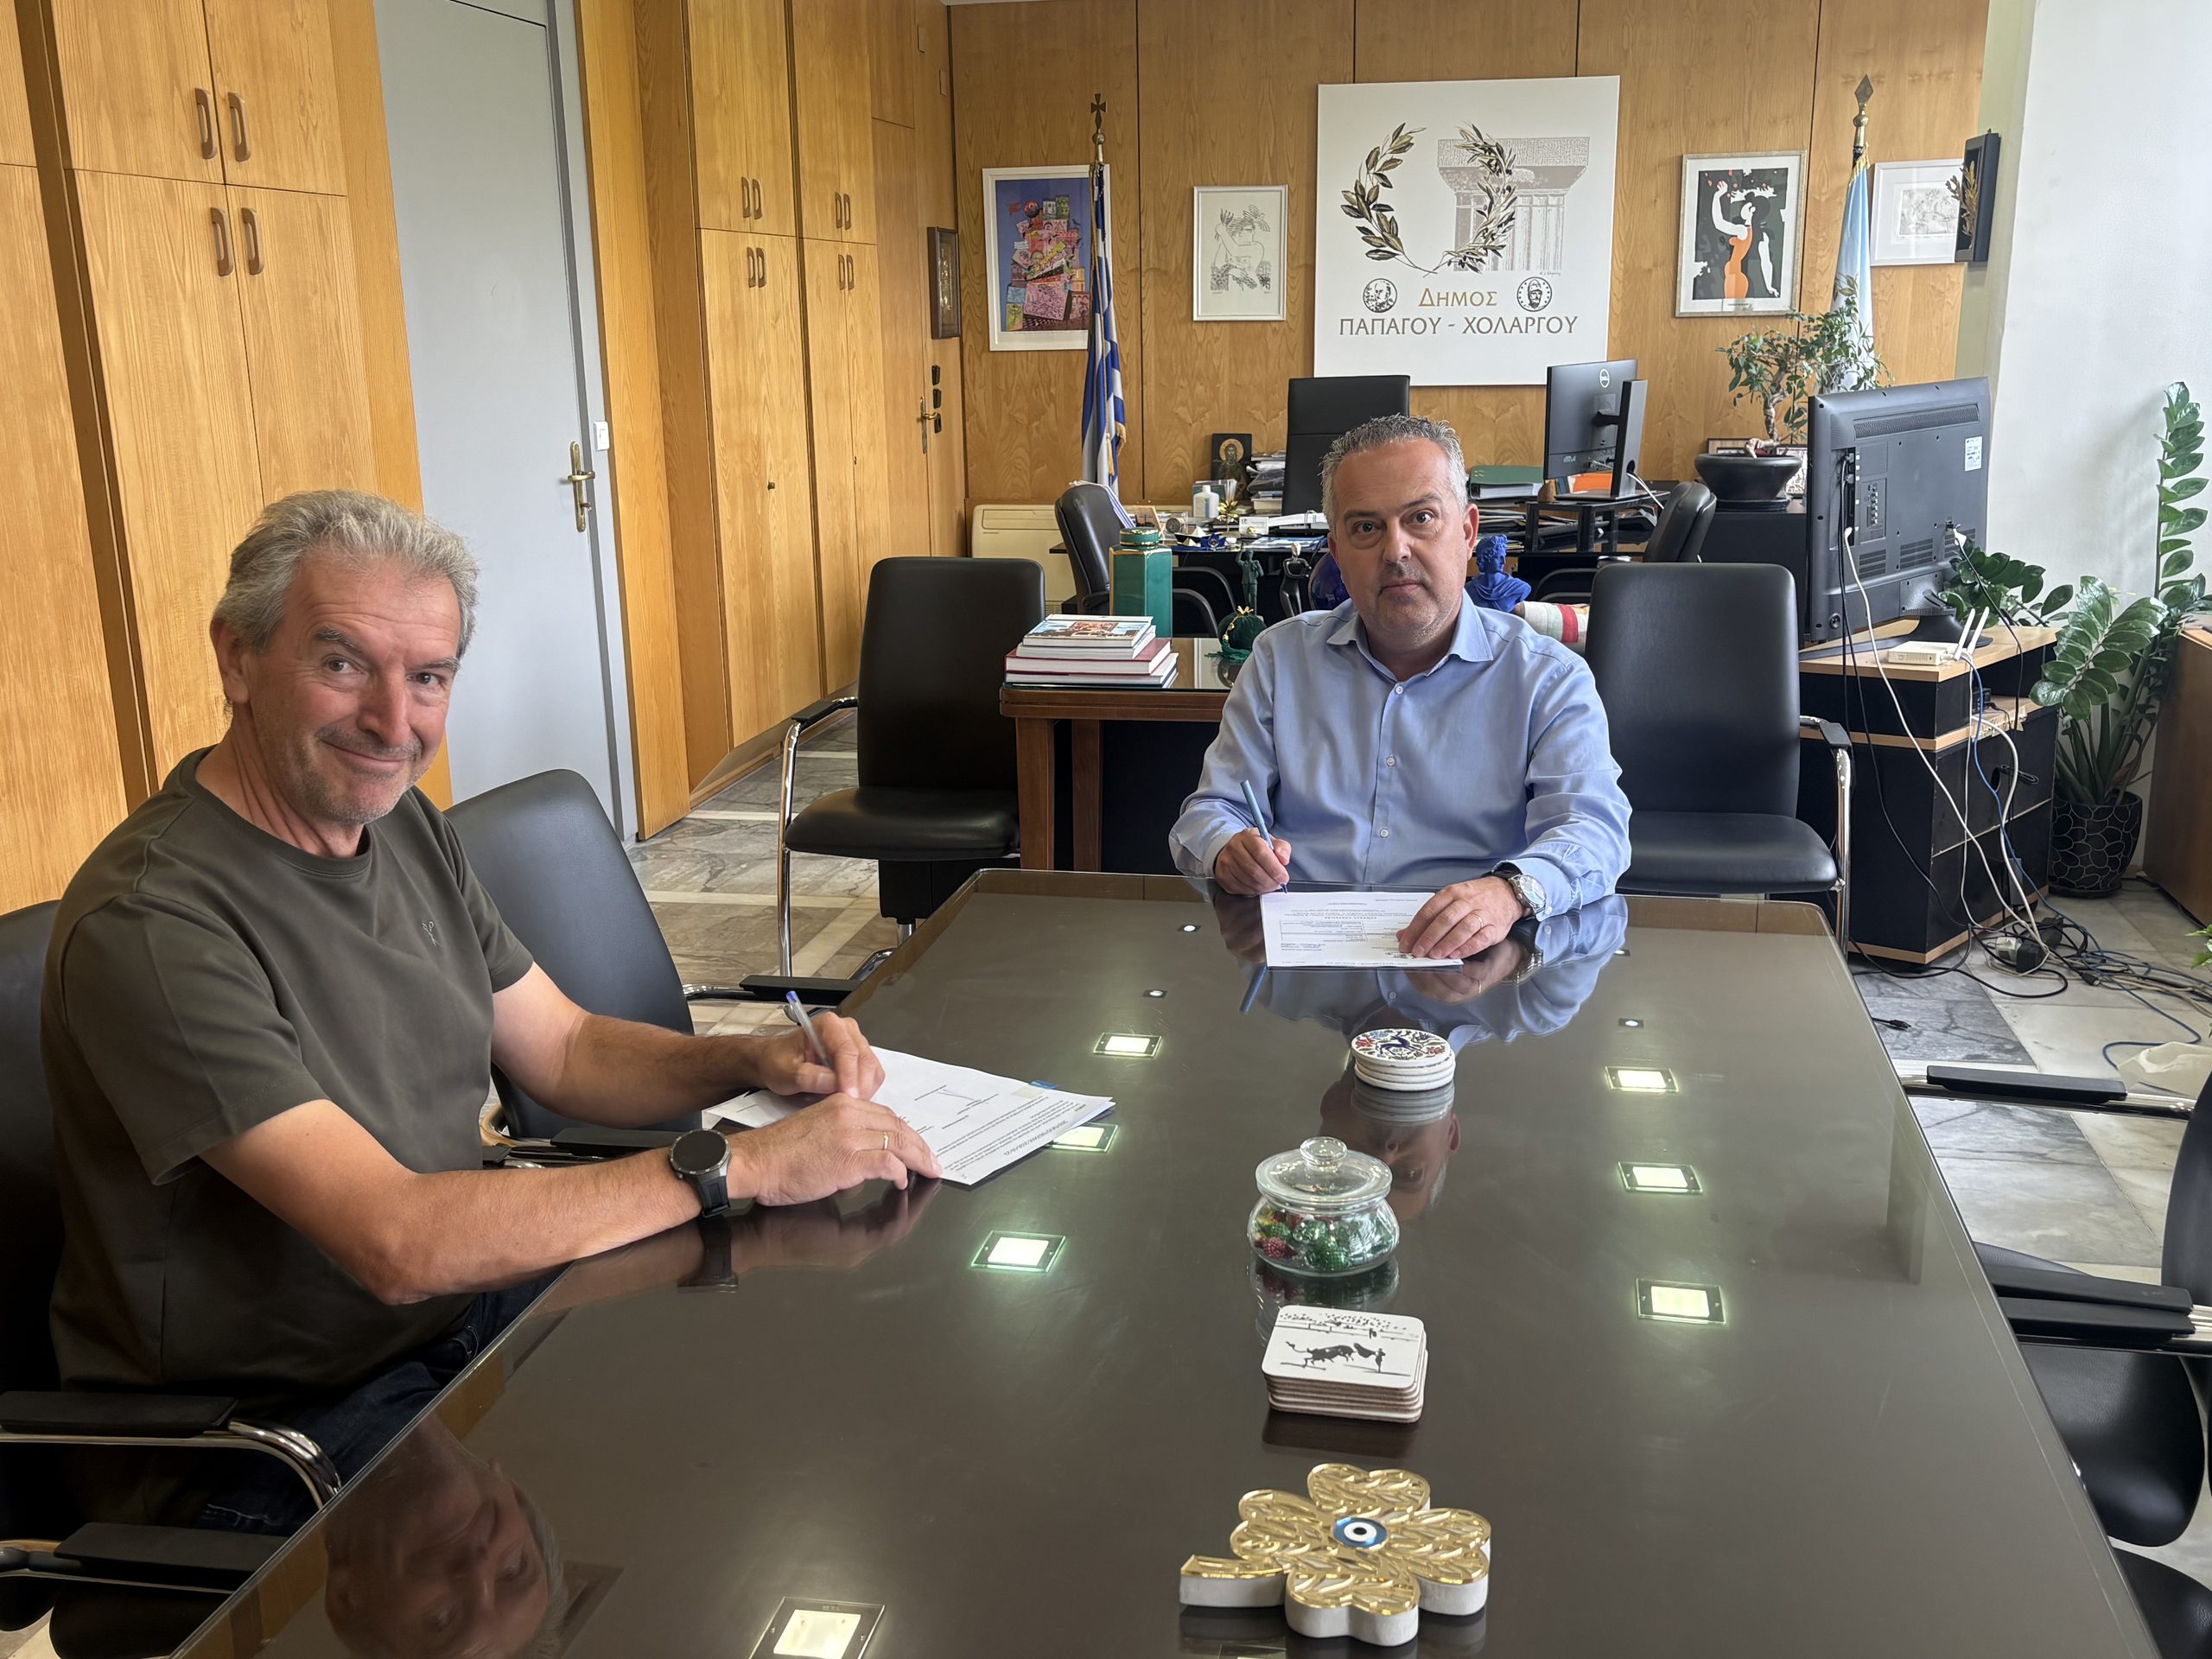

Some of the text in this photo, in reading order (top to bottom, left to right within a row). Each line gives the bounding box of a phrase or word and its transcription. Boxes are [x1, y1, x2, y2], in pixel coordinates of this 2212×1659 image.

[1418, 288, 1497, 308] ΔΗΜΟΣ
[1339, 316, 1441, 335] ΠΑΠΑΓΟΥ
[1462, 315, 1579, 334] ΧΟΛΑΡΓΟΥ
